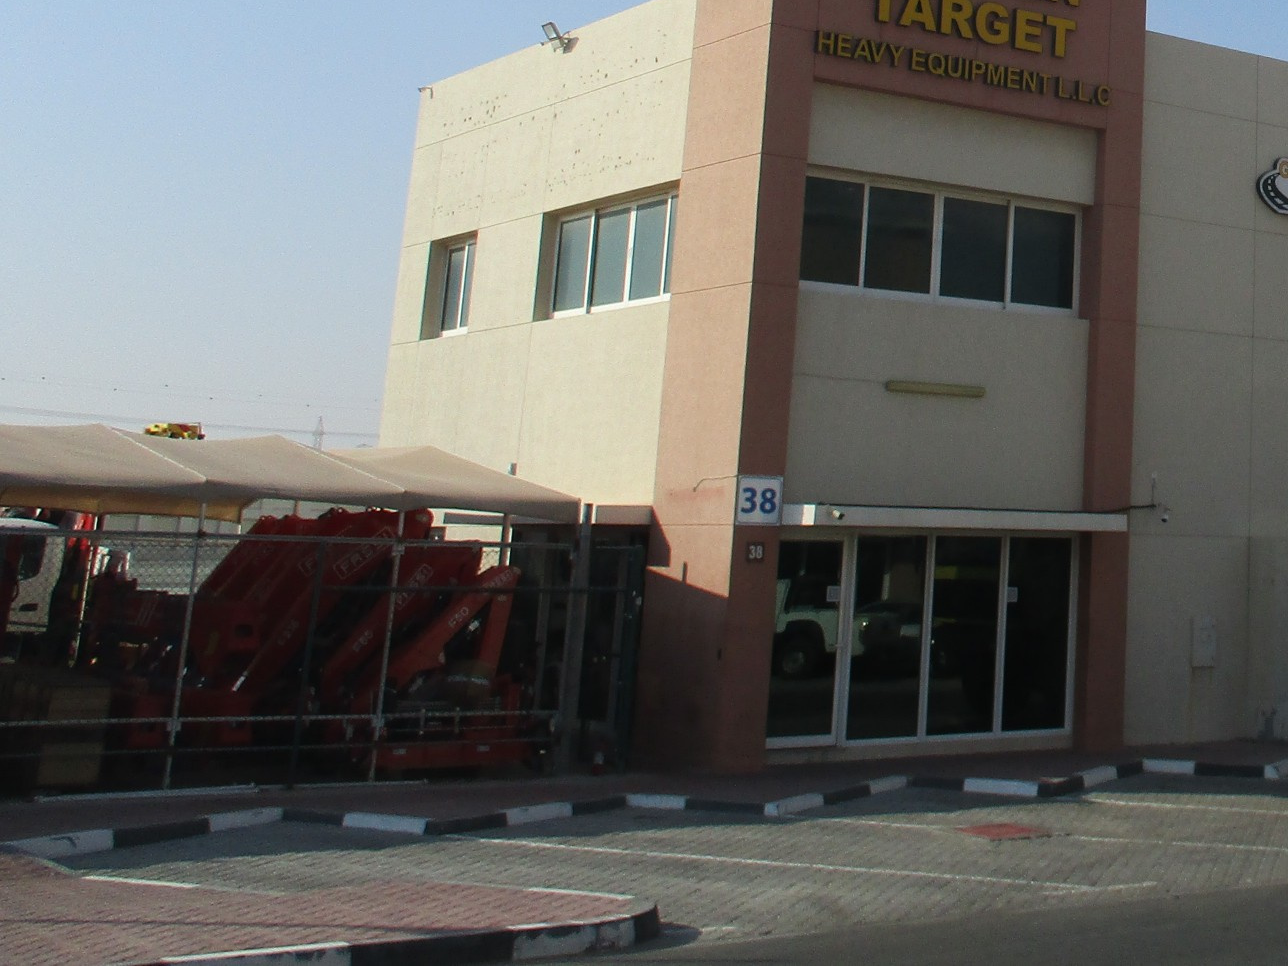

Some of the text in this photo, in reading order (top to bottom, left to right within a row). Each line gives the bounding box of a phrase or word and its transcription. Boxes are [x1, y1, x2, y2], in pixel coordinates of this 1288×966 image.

[815, 30, 904, 66] HEAVY
[910, 49, 1050, 94] EQUIPMENT
[741, 487, 777, 514] 38
[748, 544, 764, 560] 38
